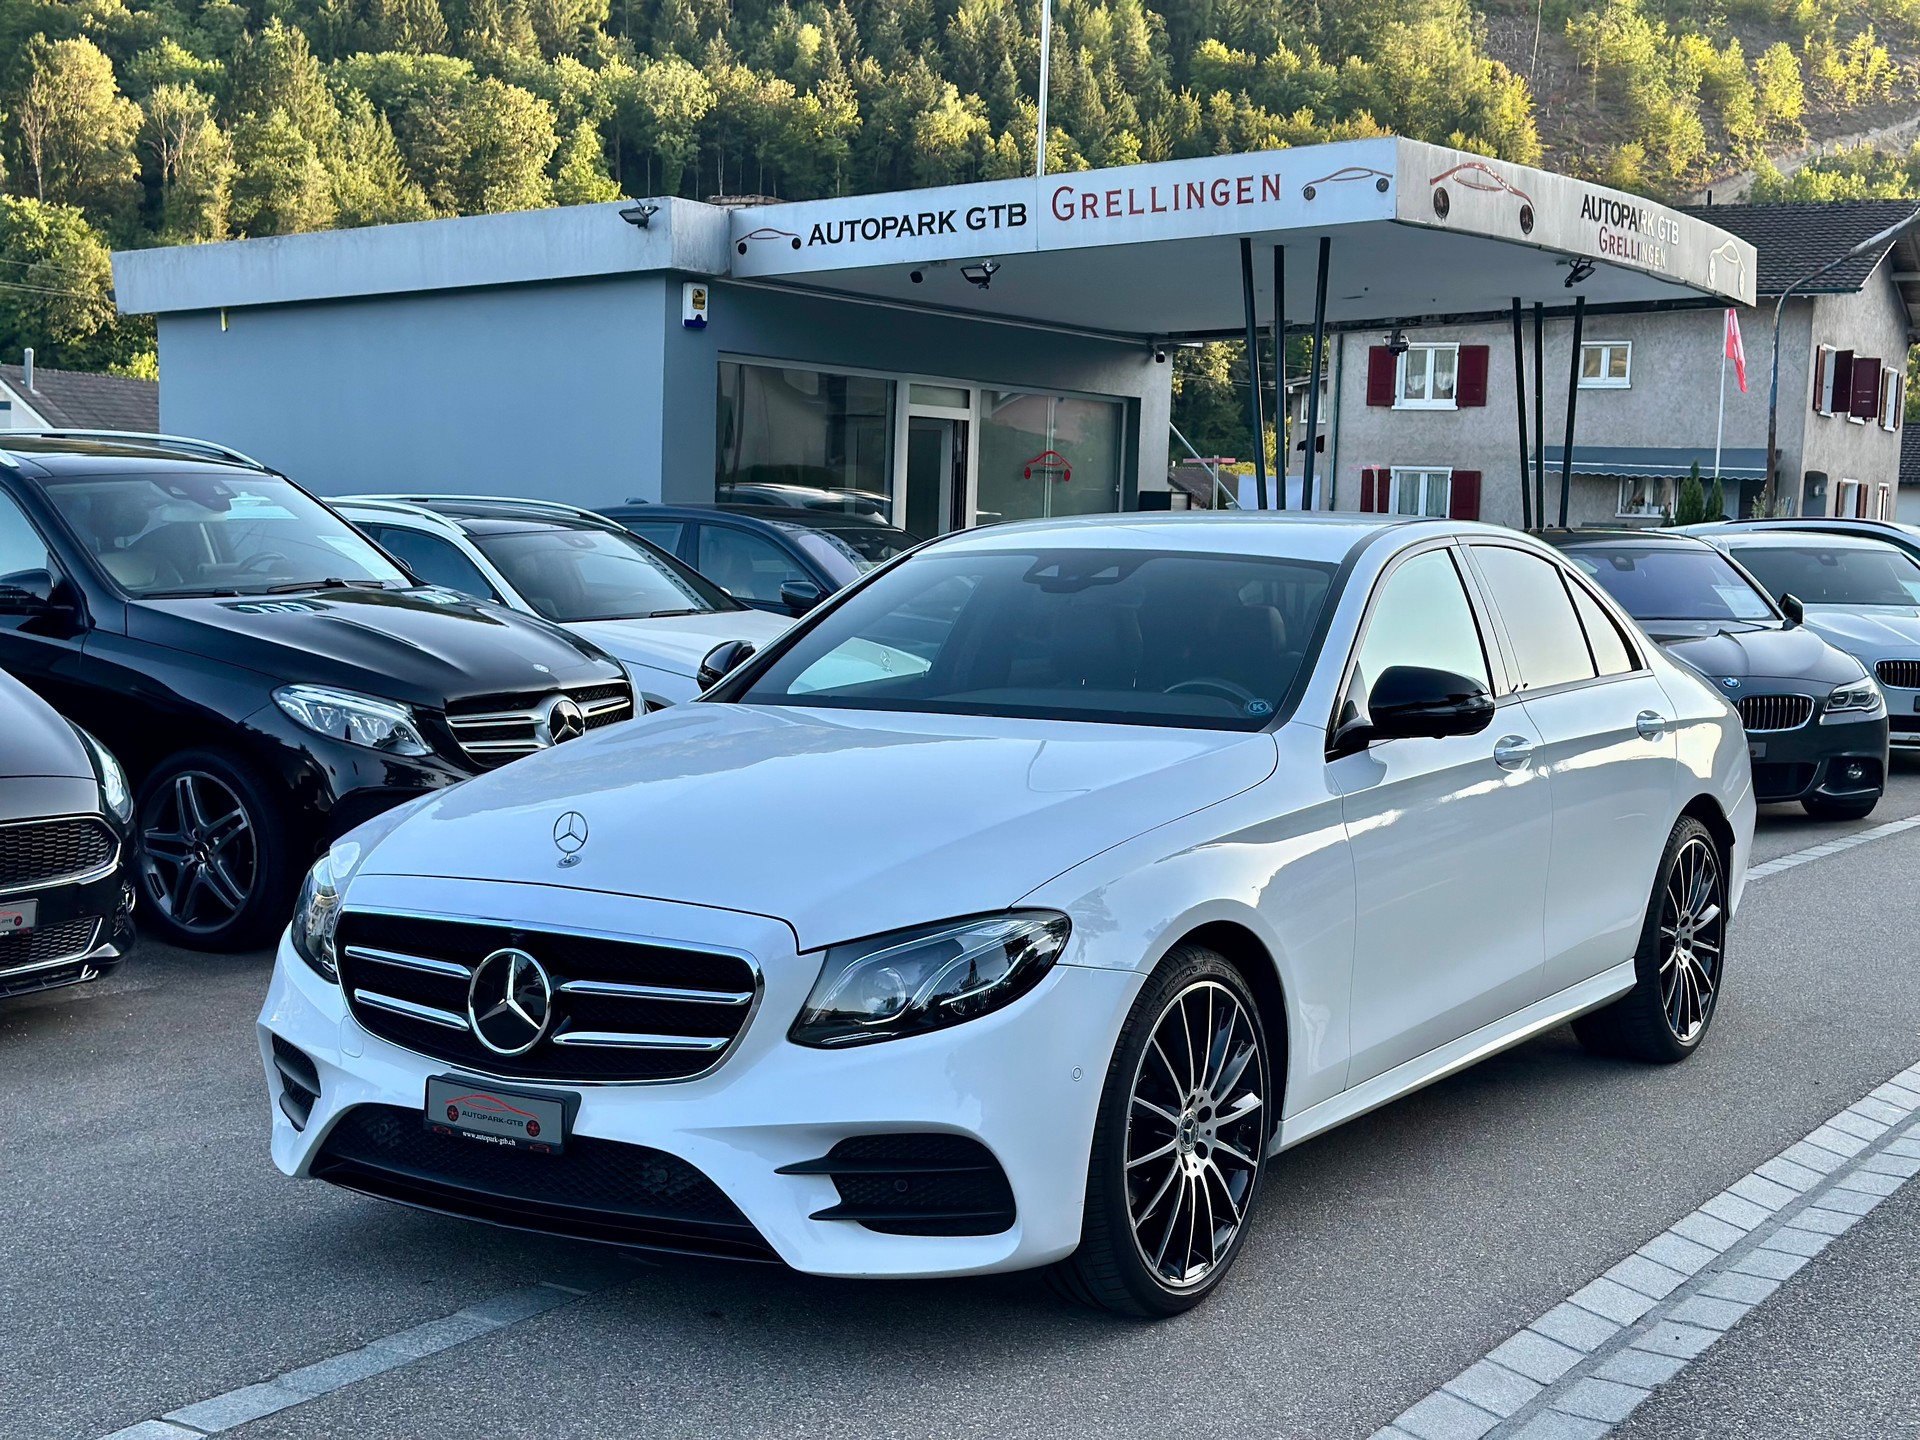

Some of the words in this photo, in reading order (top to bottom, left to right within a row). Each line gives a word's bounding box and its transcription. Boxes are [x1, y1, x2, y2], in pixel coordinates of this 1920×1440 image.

[1051, 173, 1281, 222] GRELLINGEN
[807, 209, 958, 247] AUTOPARK
[965, 202, 1028, 231] GTB
[1580, 194, 1655, 237] AUTOPARK
[1657, 216, 1679, 245] GTB
[1599, 226, 1666, 268] GRELLINGEN
[461, 1110, 524, 1127] AUTOPARK-GTB
[462, 1131, 516, 1146] www.autopark-gtb.ch
